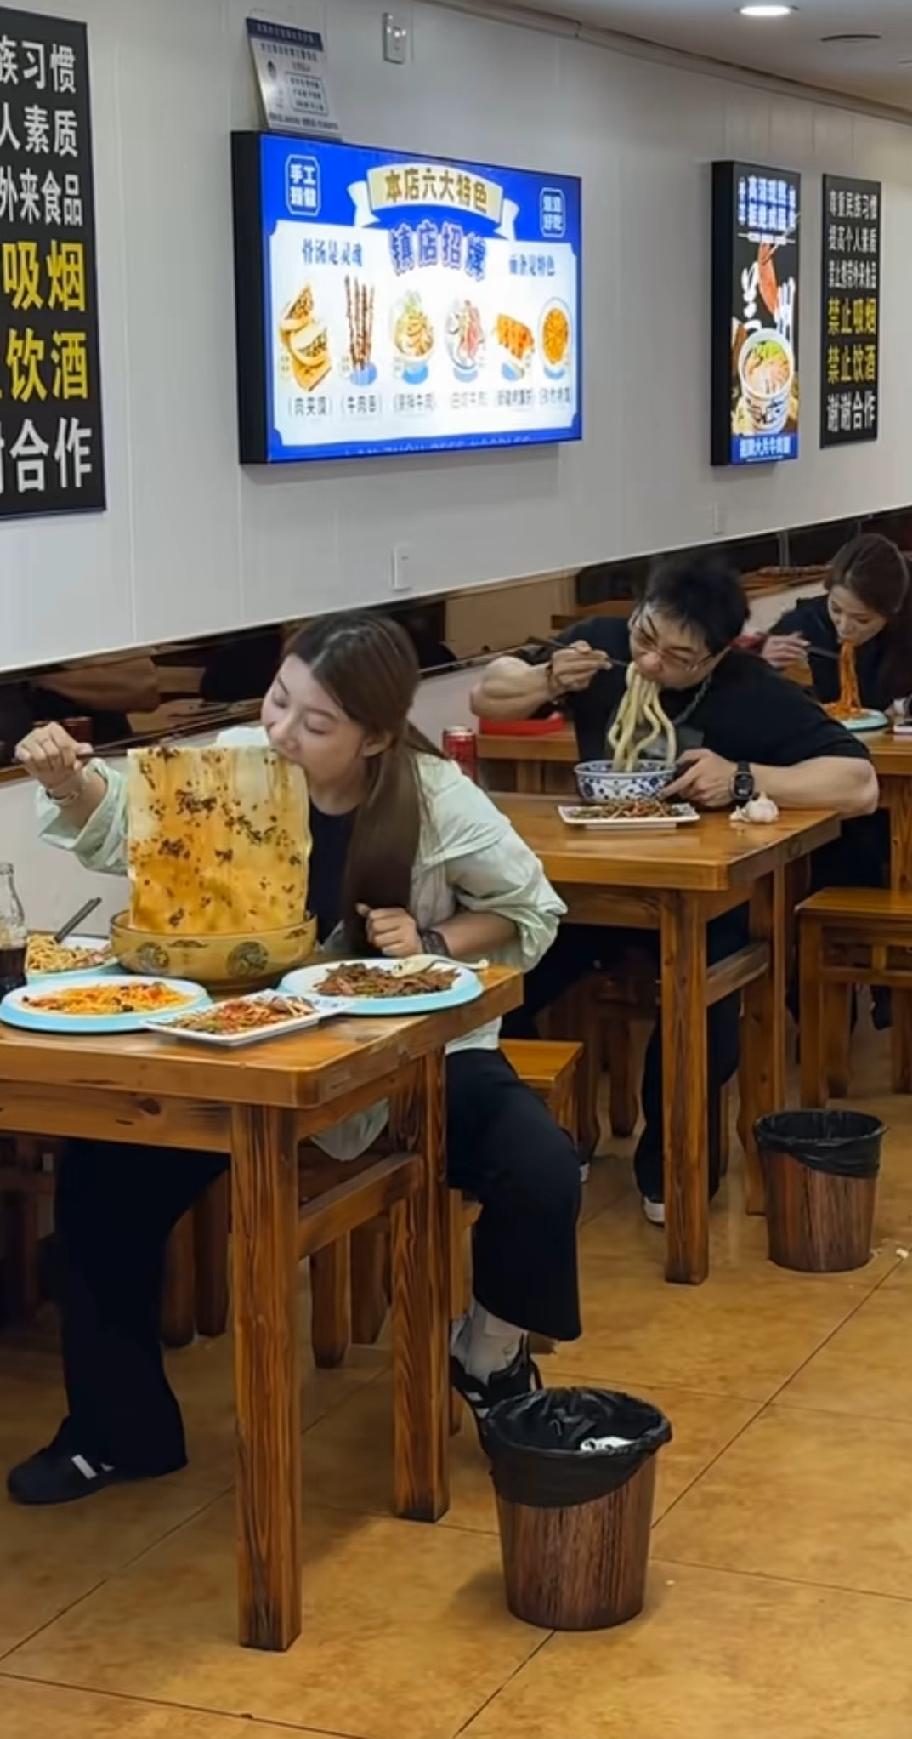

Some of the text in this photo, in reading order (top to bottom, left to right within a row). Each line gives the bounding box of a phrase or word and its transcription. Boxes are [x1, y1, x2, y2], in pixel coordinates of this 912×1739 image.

[0, 102, 78, 157] 人素质
[0, 165, 83, 226] 外来食品
[385, 168, 488, 213] 本店六大特色
[2, 239, 86, 312] 吸烟
[389, 219, 487, 281] 镇店招牌
[828, 296, 877, 335] 禁止吸烟
[0, 328, 88, 402] 饮酒
[828, 344, 877, 384] 禁止饮酒
[827, 391, 877, 432] 谢谢合作
